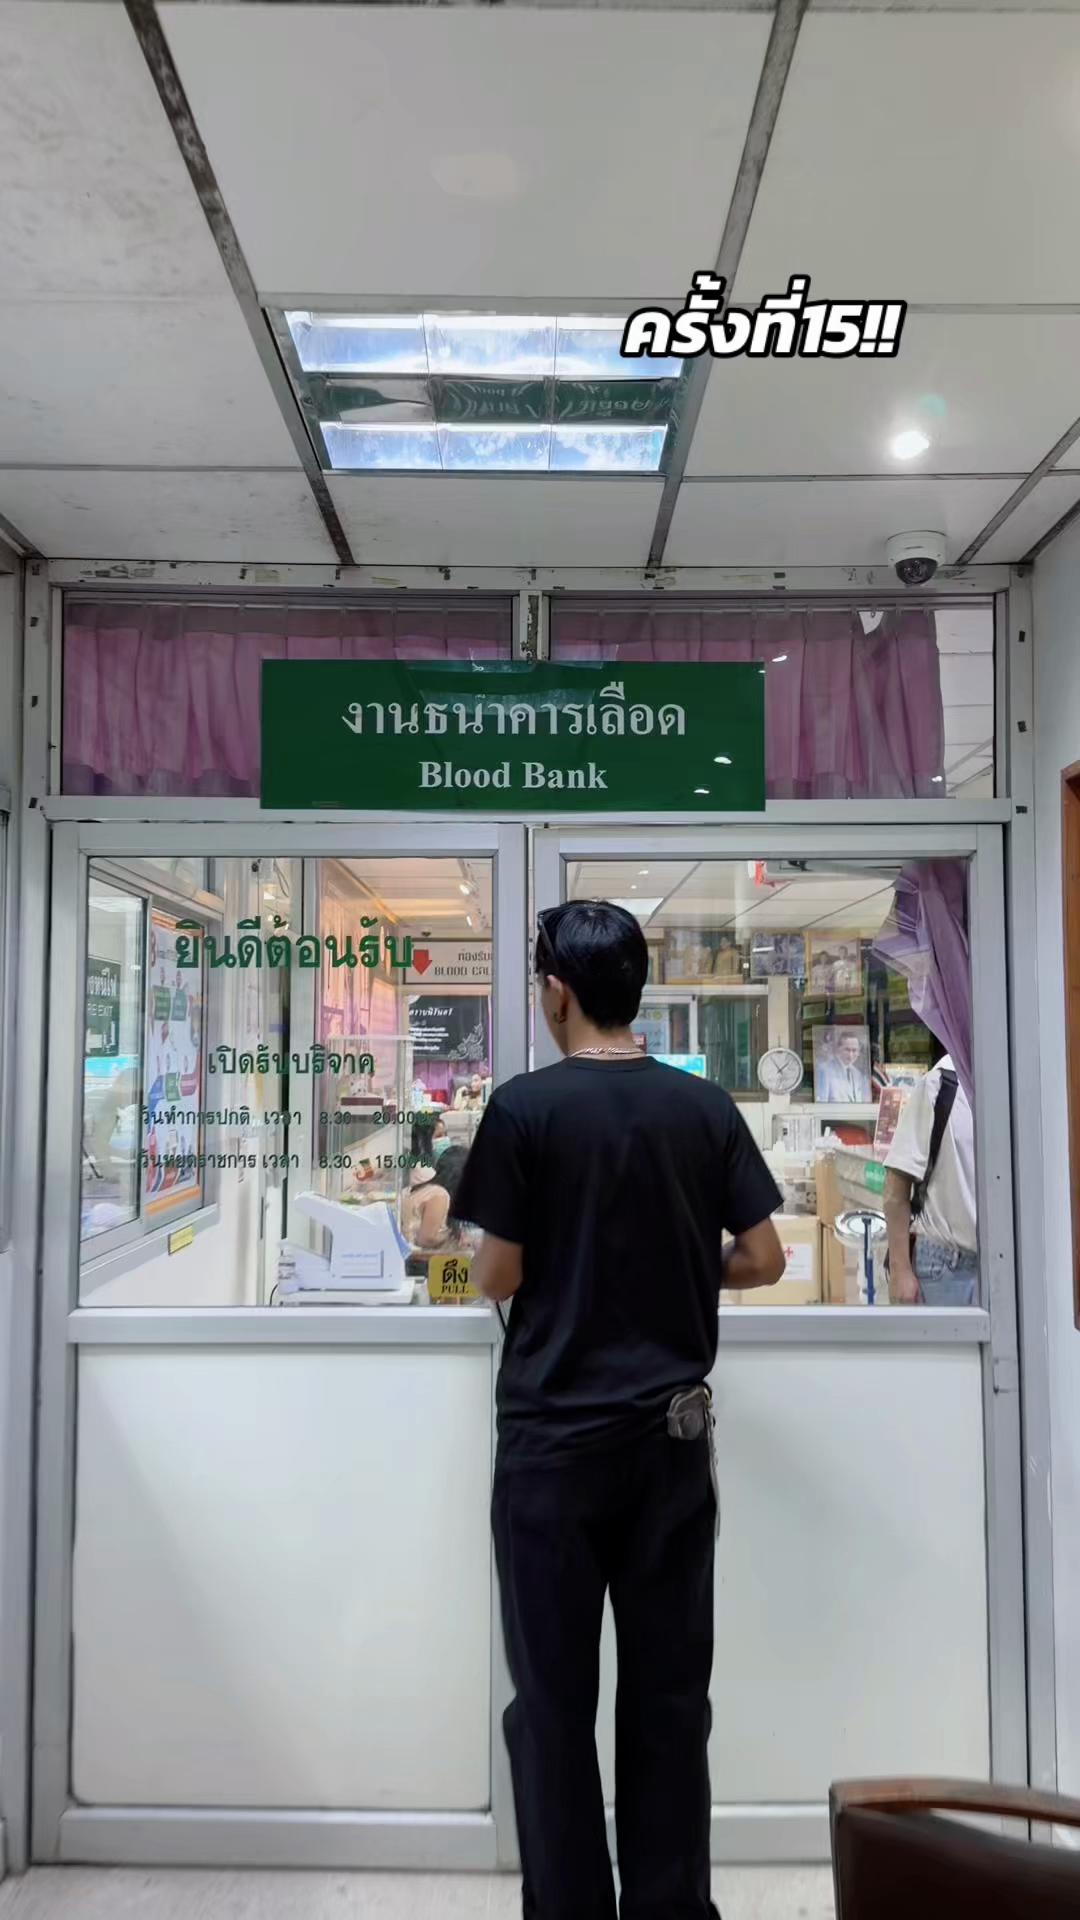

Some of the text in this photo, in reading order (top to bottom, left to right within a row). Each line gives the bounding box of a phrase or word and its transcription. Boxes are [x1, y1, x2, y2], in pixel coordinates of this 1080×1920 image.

[341, 681, 686, 736] งานธนาคารเลือด
[418, 761, 608, 789] Blood Bank
[175, 915, 413, 968] ยินดีต้อนรับ
[208, 1043, 375, 1075] เปิดรับบริจาค
[140, 1105, 250, 1126] วันทำการปกติ
[320, 1111, 352, 1126] 8.30
[442, 1258, 468, 1284] ดึง
[441, 1285, 469, 1294] PULL
